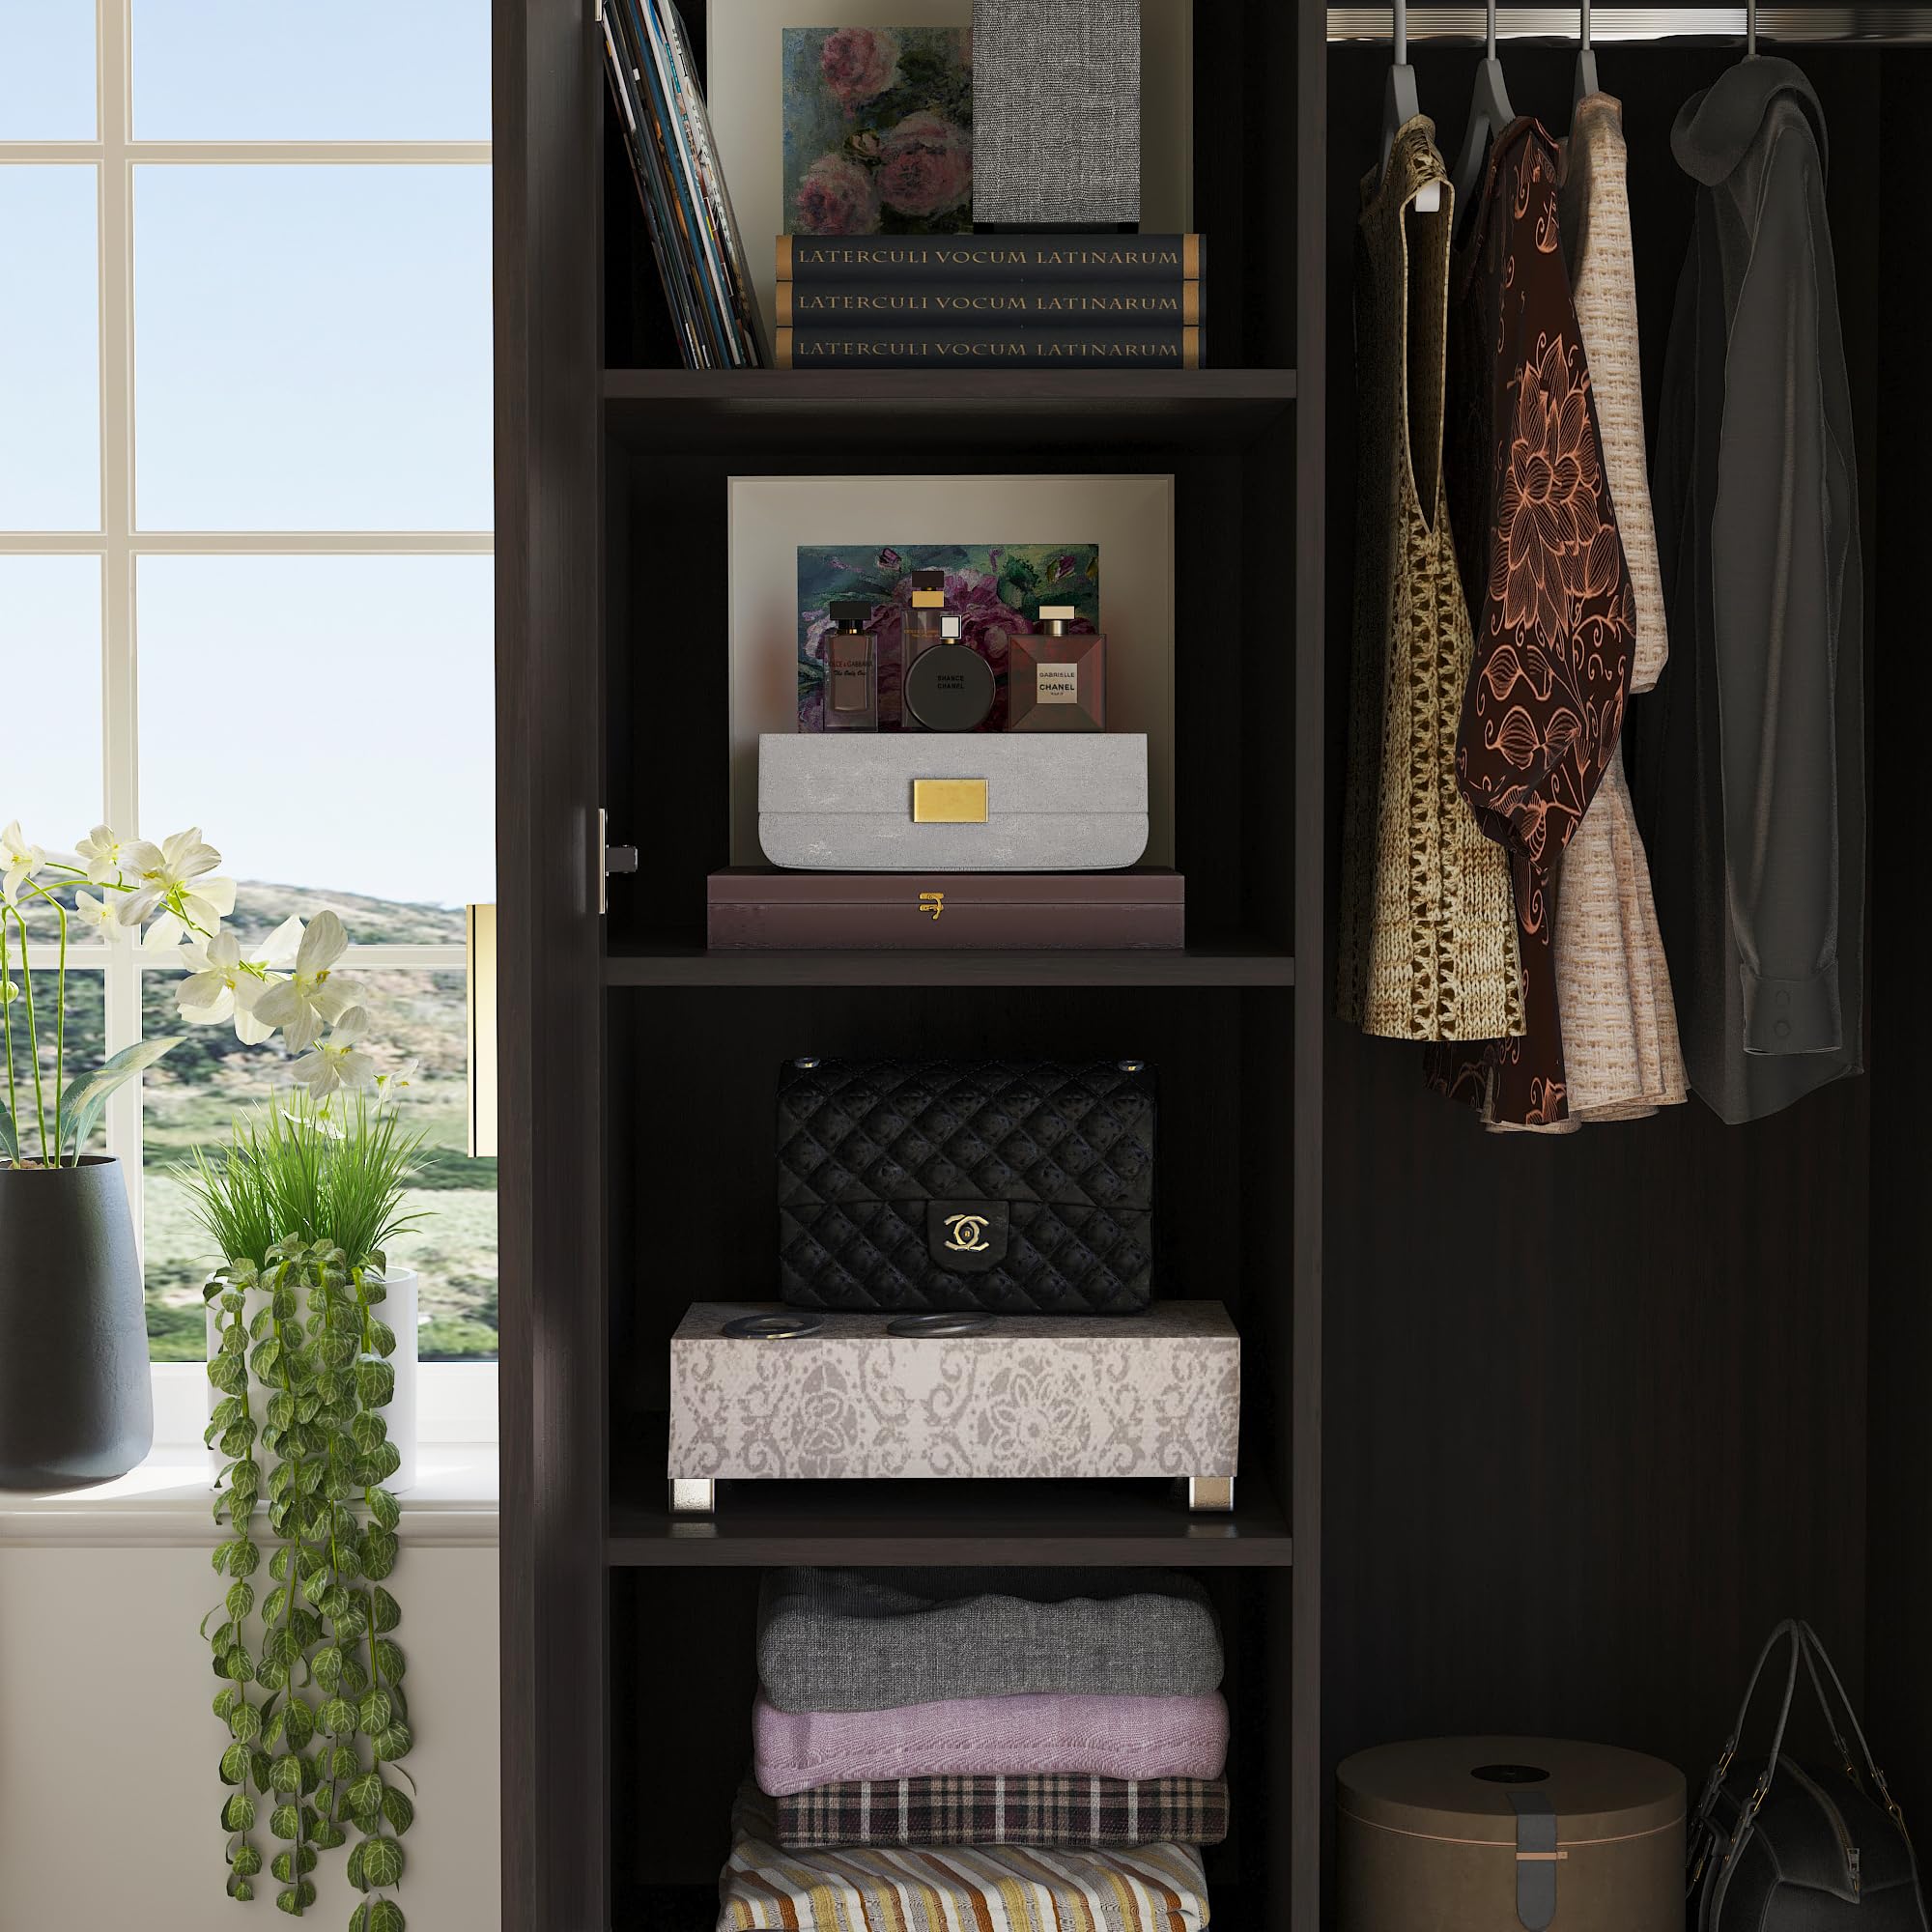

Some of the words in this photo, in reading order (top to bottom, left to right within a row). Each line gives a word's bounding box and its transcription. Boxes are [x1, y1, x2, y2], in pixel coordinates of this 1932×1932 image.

[799, 250, 928, 263] LATERCULI
[934, 251, 1028, 264] VOCUM
[1036, 251, 1179, 264] LATINARUM
[799, 297, 928, 309] LATERCULI
[934, 298, 1028, 310] VOCUM
[1036, 298, 1179, 310] LATINARUM
[799, 343, 928, 355] LATERCULI
[934, 344, 1028, 356] VOCUM
[1036, 344, 1179, 356] LATINARUM
